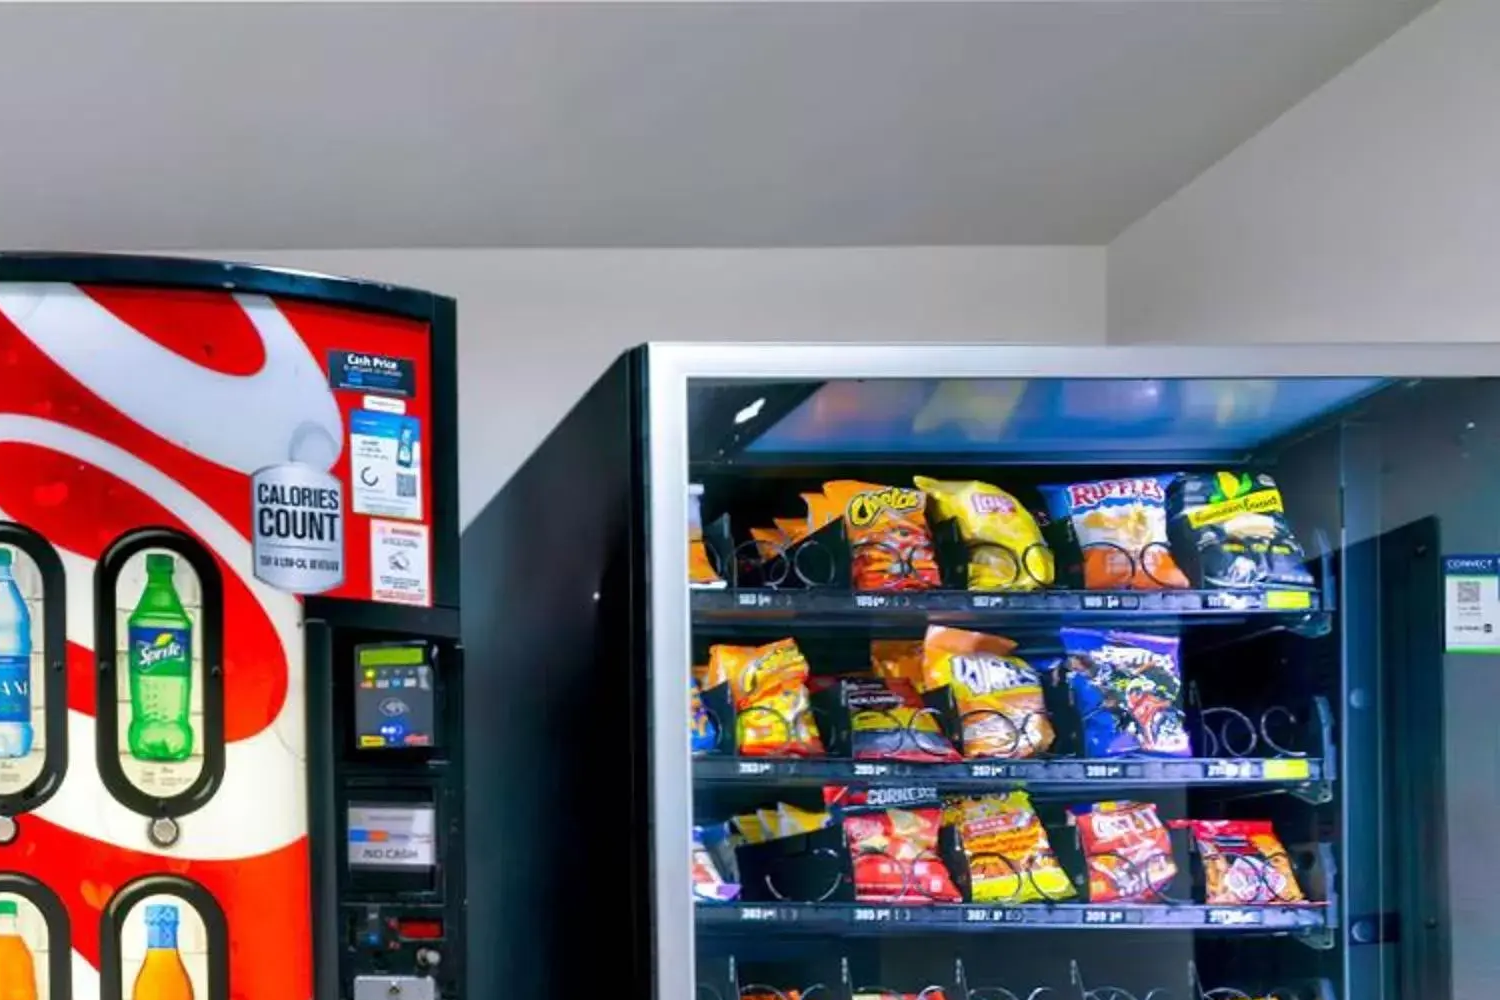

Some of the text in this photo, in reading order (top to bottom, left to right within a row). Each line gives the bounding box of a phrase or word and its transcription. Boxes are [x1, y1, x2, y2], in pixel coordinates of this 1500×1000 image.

[347, 353, 398, 370] Cash Price
[258, 483, 338, 510] CALORIES
[259, 508, 340, 541] COUNT
[140, 642, 183, 666] Sprite
[363, 849, 382, 859] NO
